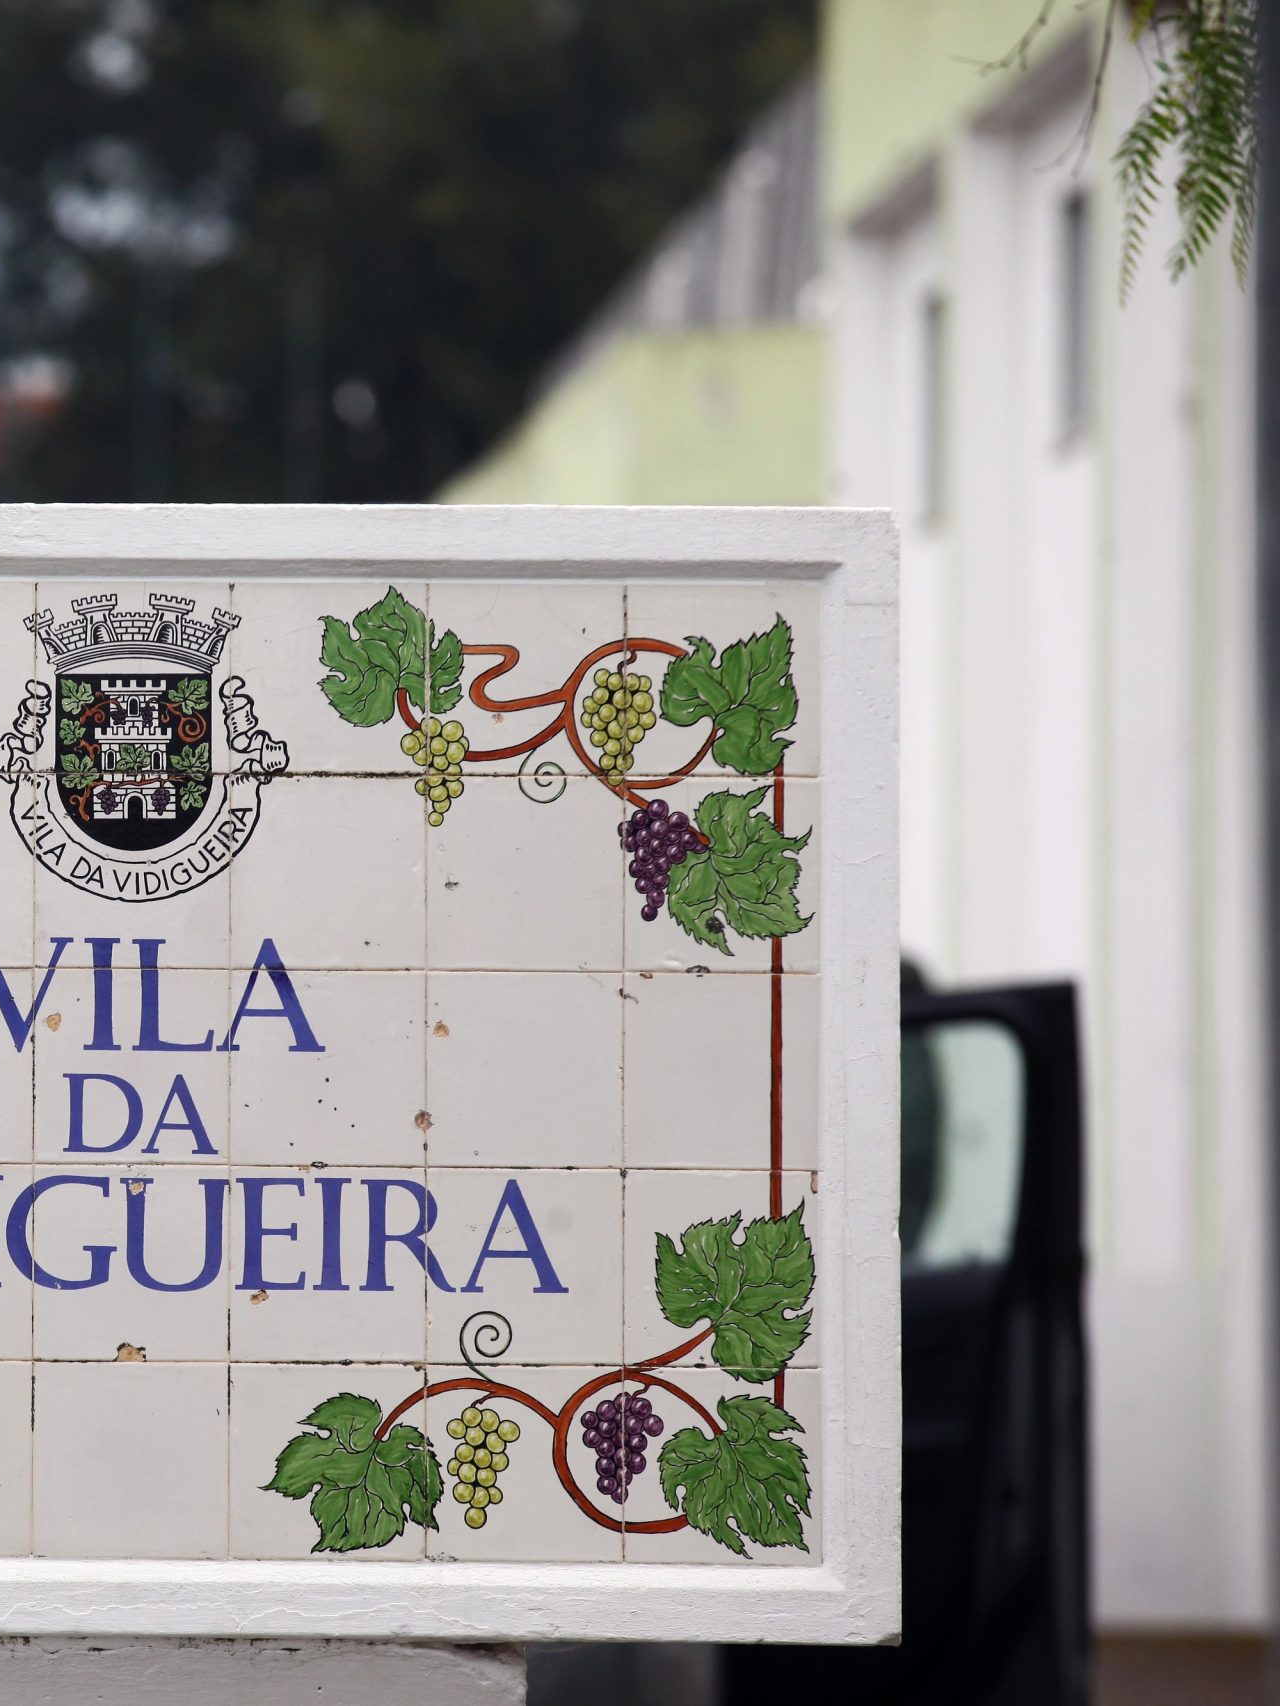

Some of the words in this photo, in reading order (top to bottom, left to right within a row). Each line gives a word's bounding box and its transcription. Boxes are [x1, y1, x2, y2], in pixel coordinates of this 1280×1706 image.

[21, 801, 67, 866] VILA
[70, 856, 105, 889] DA
[112, 807, 253, 895] VIDIGUEIRA
[63, 1073, 219, 1155] DA
